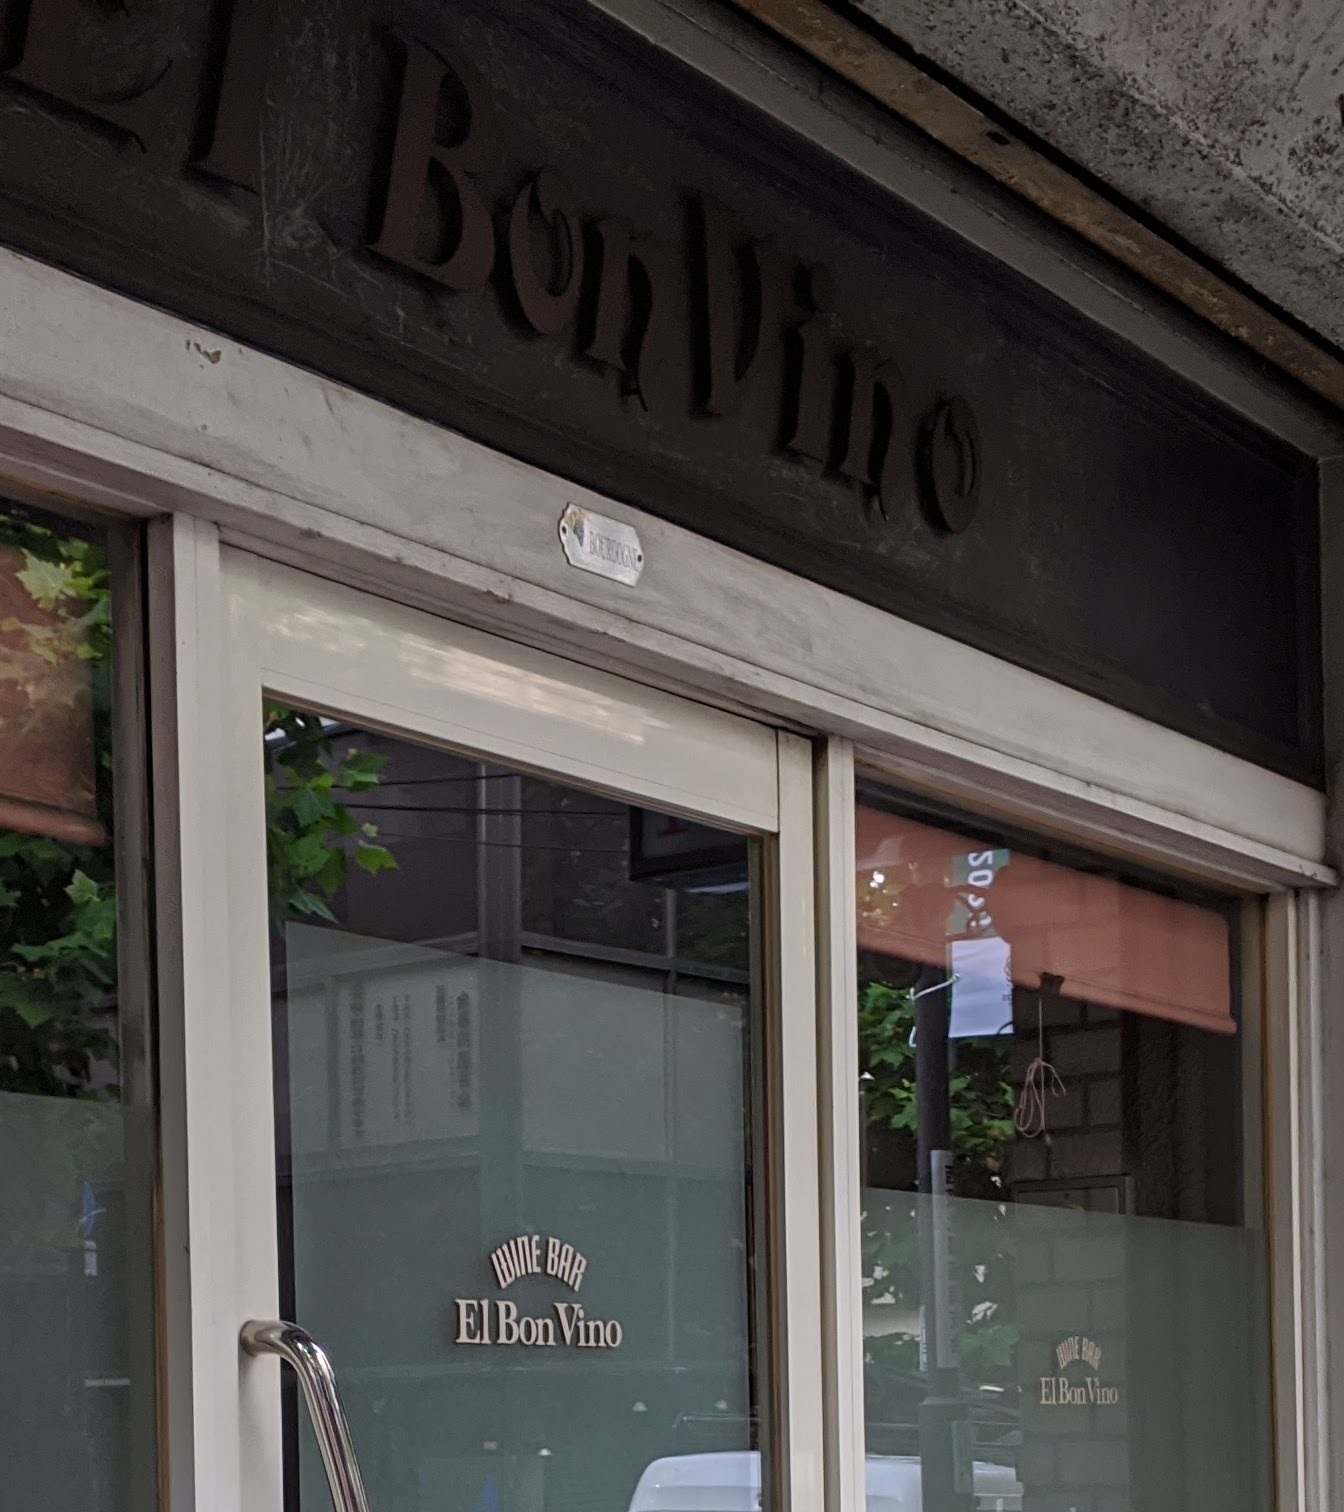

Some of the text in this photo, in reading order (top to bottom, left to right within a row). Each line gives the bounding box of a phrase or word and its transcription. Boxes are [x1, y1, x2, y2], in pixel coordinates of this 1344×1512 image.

[490, 1234, 587, 1292] WINE BAR
[454, 1298, 623, 1348] El Bon Vino
[1040, 1377, 1119, 1404] El Bon Vino
